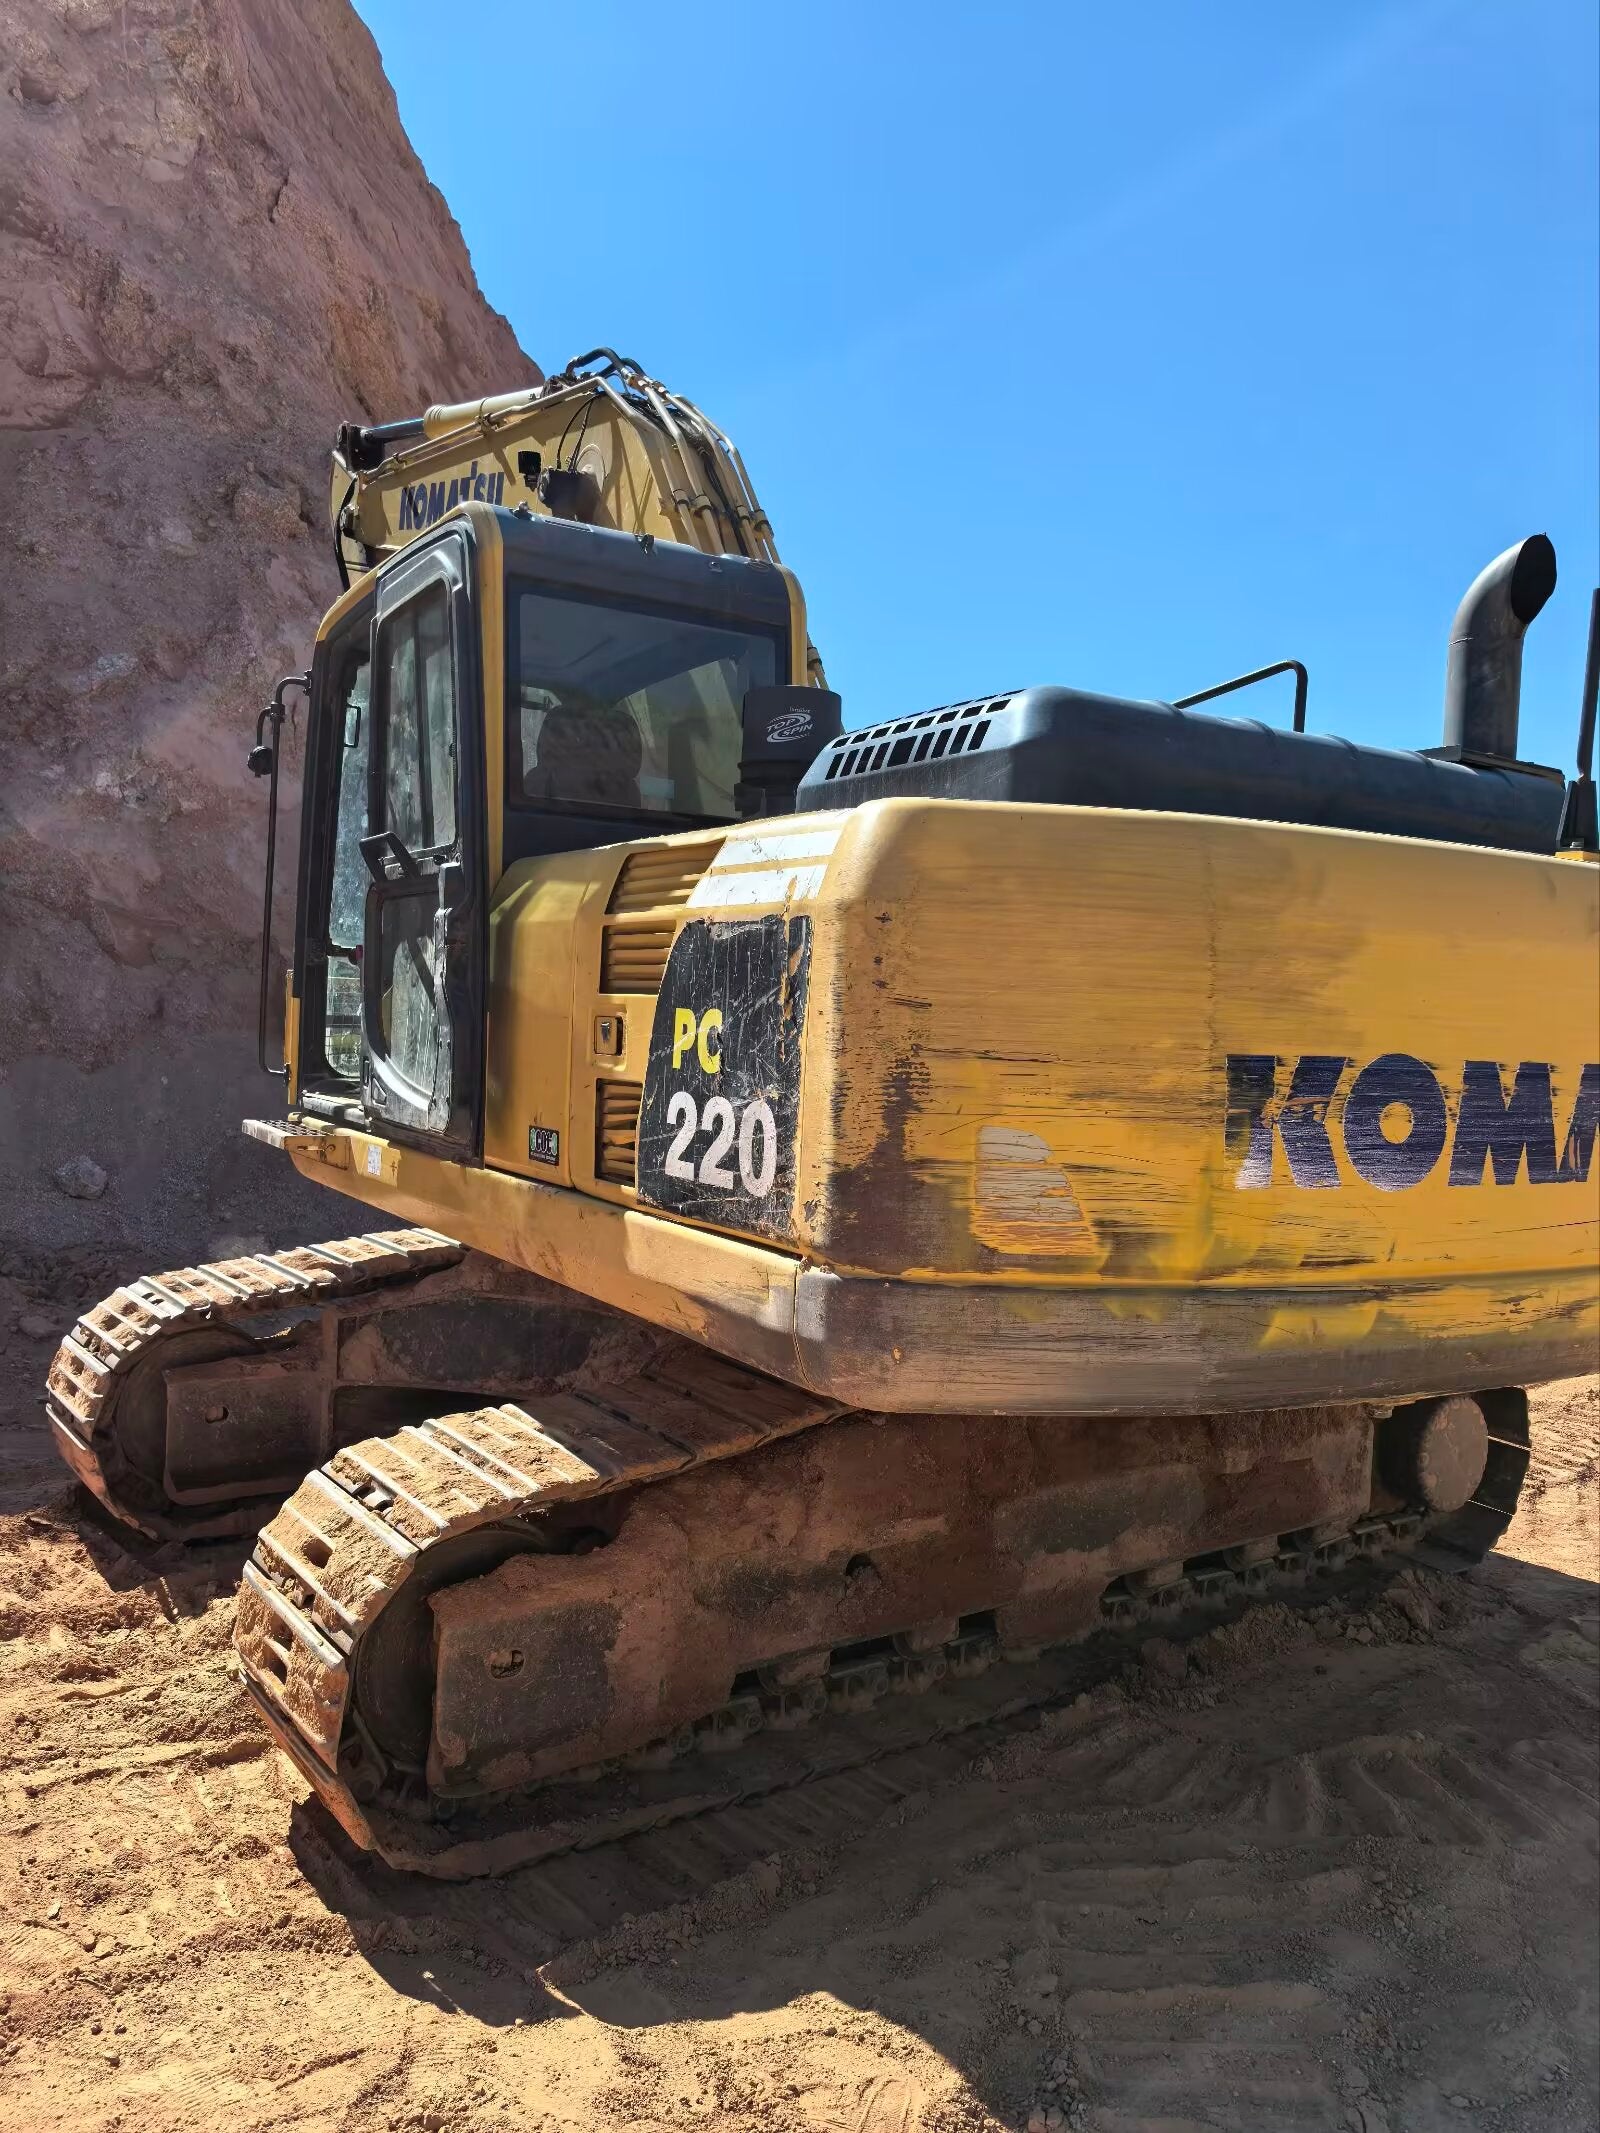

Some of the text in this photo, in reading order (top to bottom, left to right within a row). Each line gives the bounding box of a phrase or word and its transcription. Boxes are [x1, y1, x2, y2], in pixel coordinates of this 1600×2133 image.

[399, 461, 505, 530] KOMATSU
[767, 718, 796, 733] TOP
[781, 723, 813, 737] SPIN
[672, 1008, 723, 1074] PC
[665, 1091, 777, 1197] 220
